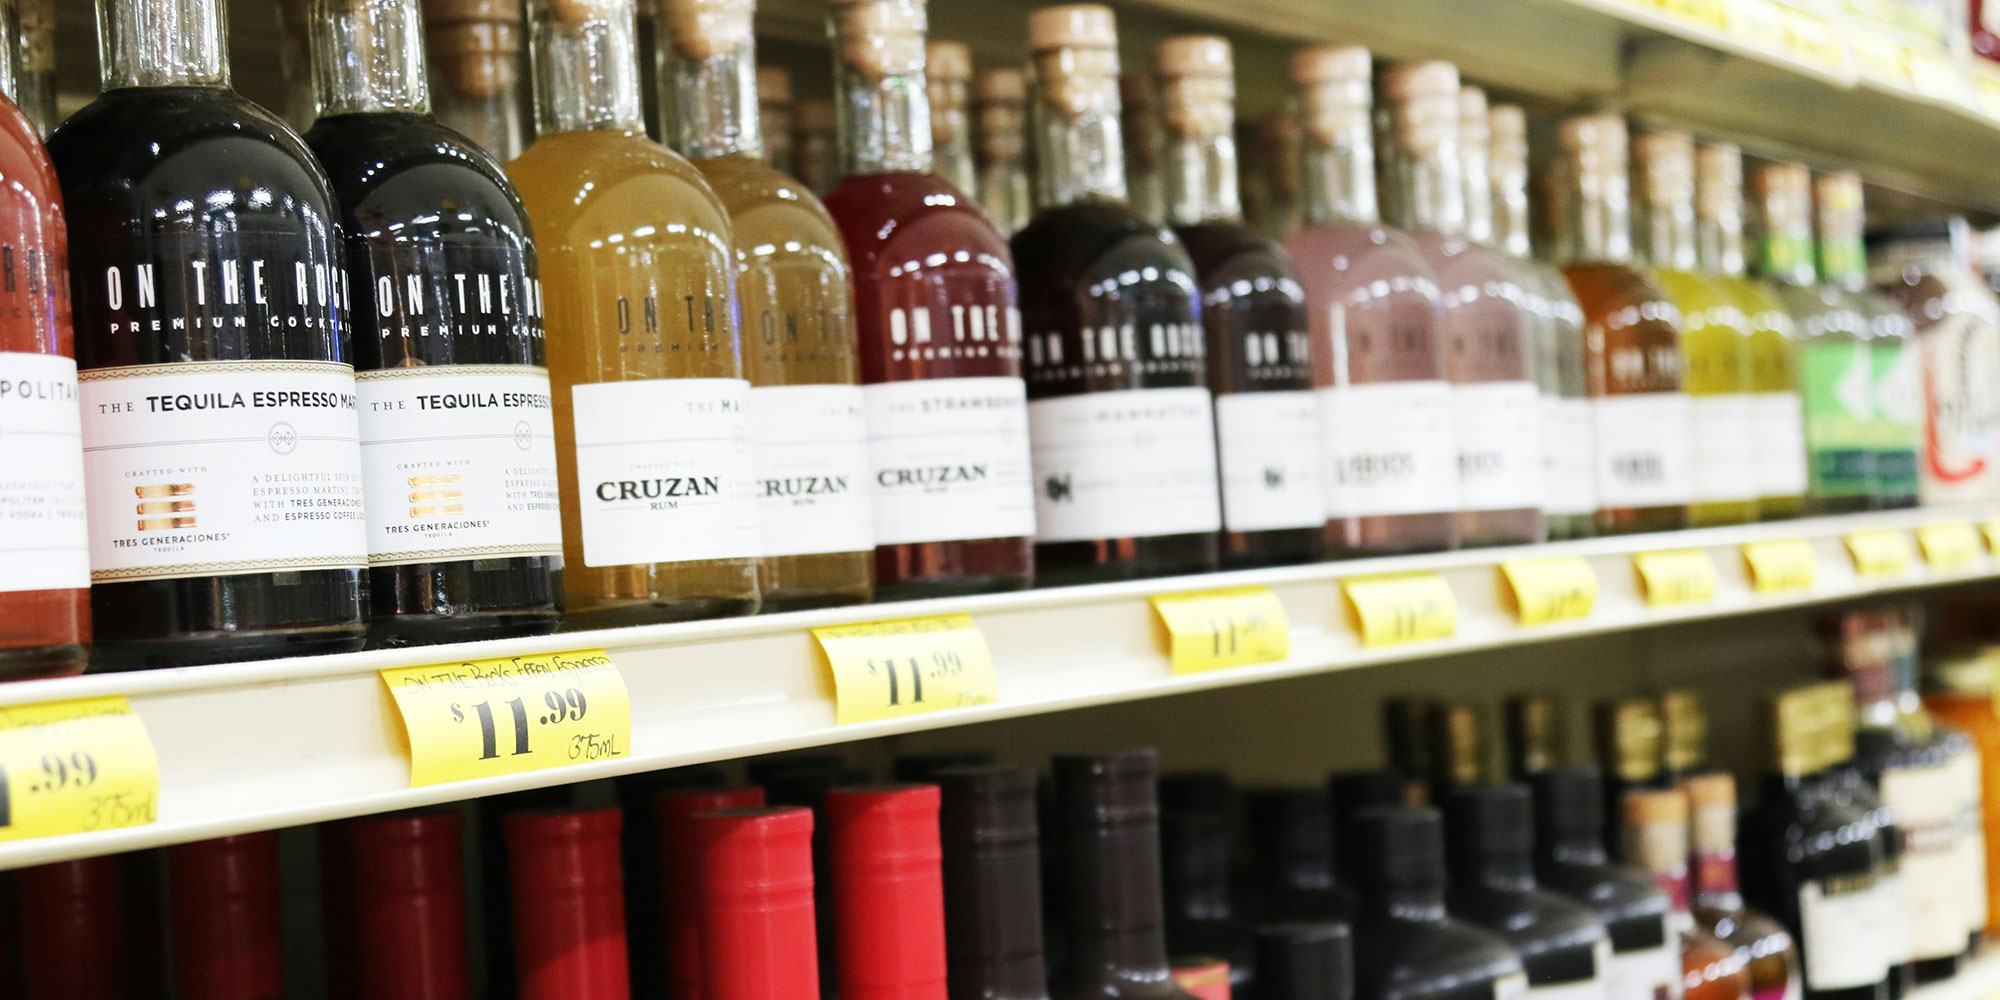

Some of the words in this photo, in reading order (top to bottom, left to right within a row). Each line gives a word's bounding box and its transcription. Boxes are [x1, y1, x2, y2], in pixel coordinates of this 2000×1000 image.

[107, 264, 155, 311] ON
[192, 260, 268, 305] THE
[378, 274, 424, 317] ON
[454, 274, 511, 315] THE
[618, 296, 657, 334] ON
[111, 317, 246, 334] PREMIUM
[382, 325, 497, 339] PREMIUM
[98, 402, 134, 414] THE
[146, 393, 246, 412] TEQUILA
[253, 391, 338, 408] ESPRESSO
[371, 400, 406, 411] THE
[416, 393, 498, 410] TEQUILA
[124, 468, 173, 478] CRAFTED
[179, 466, 207, 474] WITH
[396, 461, 441, 470] CRAFTED
[251, 474, 259, 483] A
[265, 472, 331, 483] DELIGHTFUL
[877, 463, 987, 488] CRUZAN
[253, 485, 309, 496] ESPRESSO
[595, 476, 720, 502] CRUZAN
[253, 499, 285, 509] WITH
[291, 498, 314, 508] TRES
[507, 503, 524, 511] AND
[650, 500, 678, 510] RUM
[254, 513, 280, 523] AND
[285, 511, 331, 521] ESPRESSO
[333, 511, 356, 520] COFFEE
[385, 525, 410, 534] TRES
[113, 538, 138, 549] TRES
[867, 651, 963, 708] $11.99
[451, 688, 588, 760] $11.99
